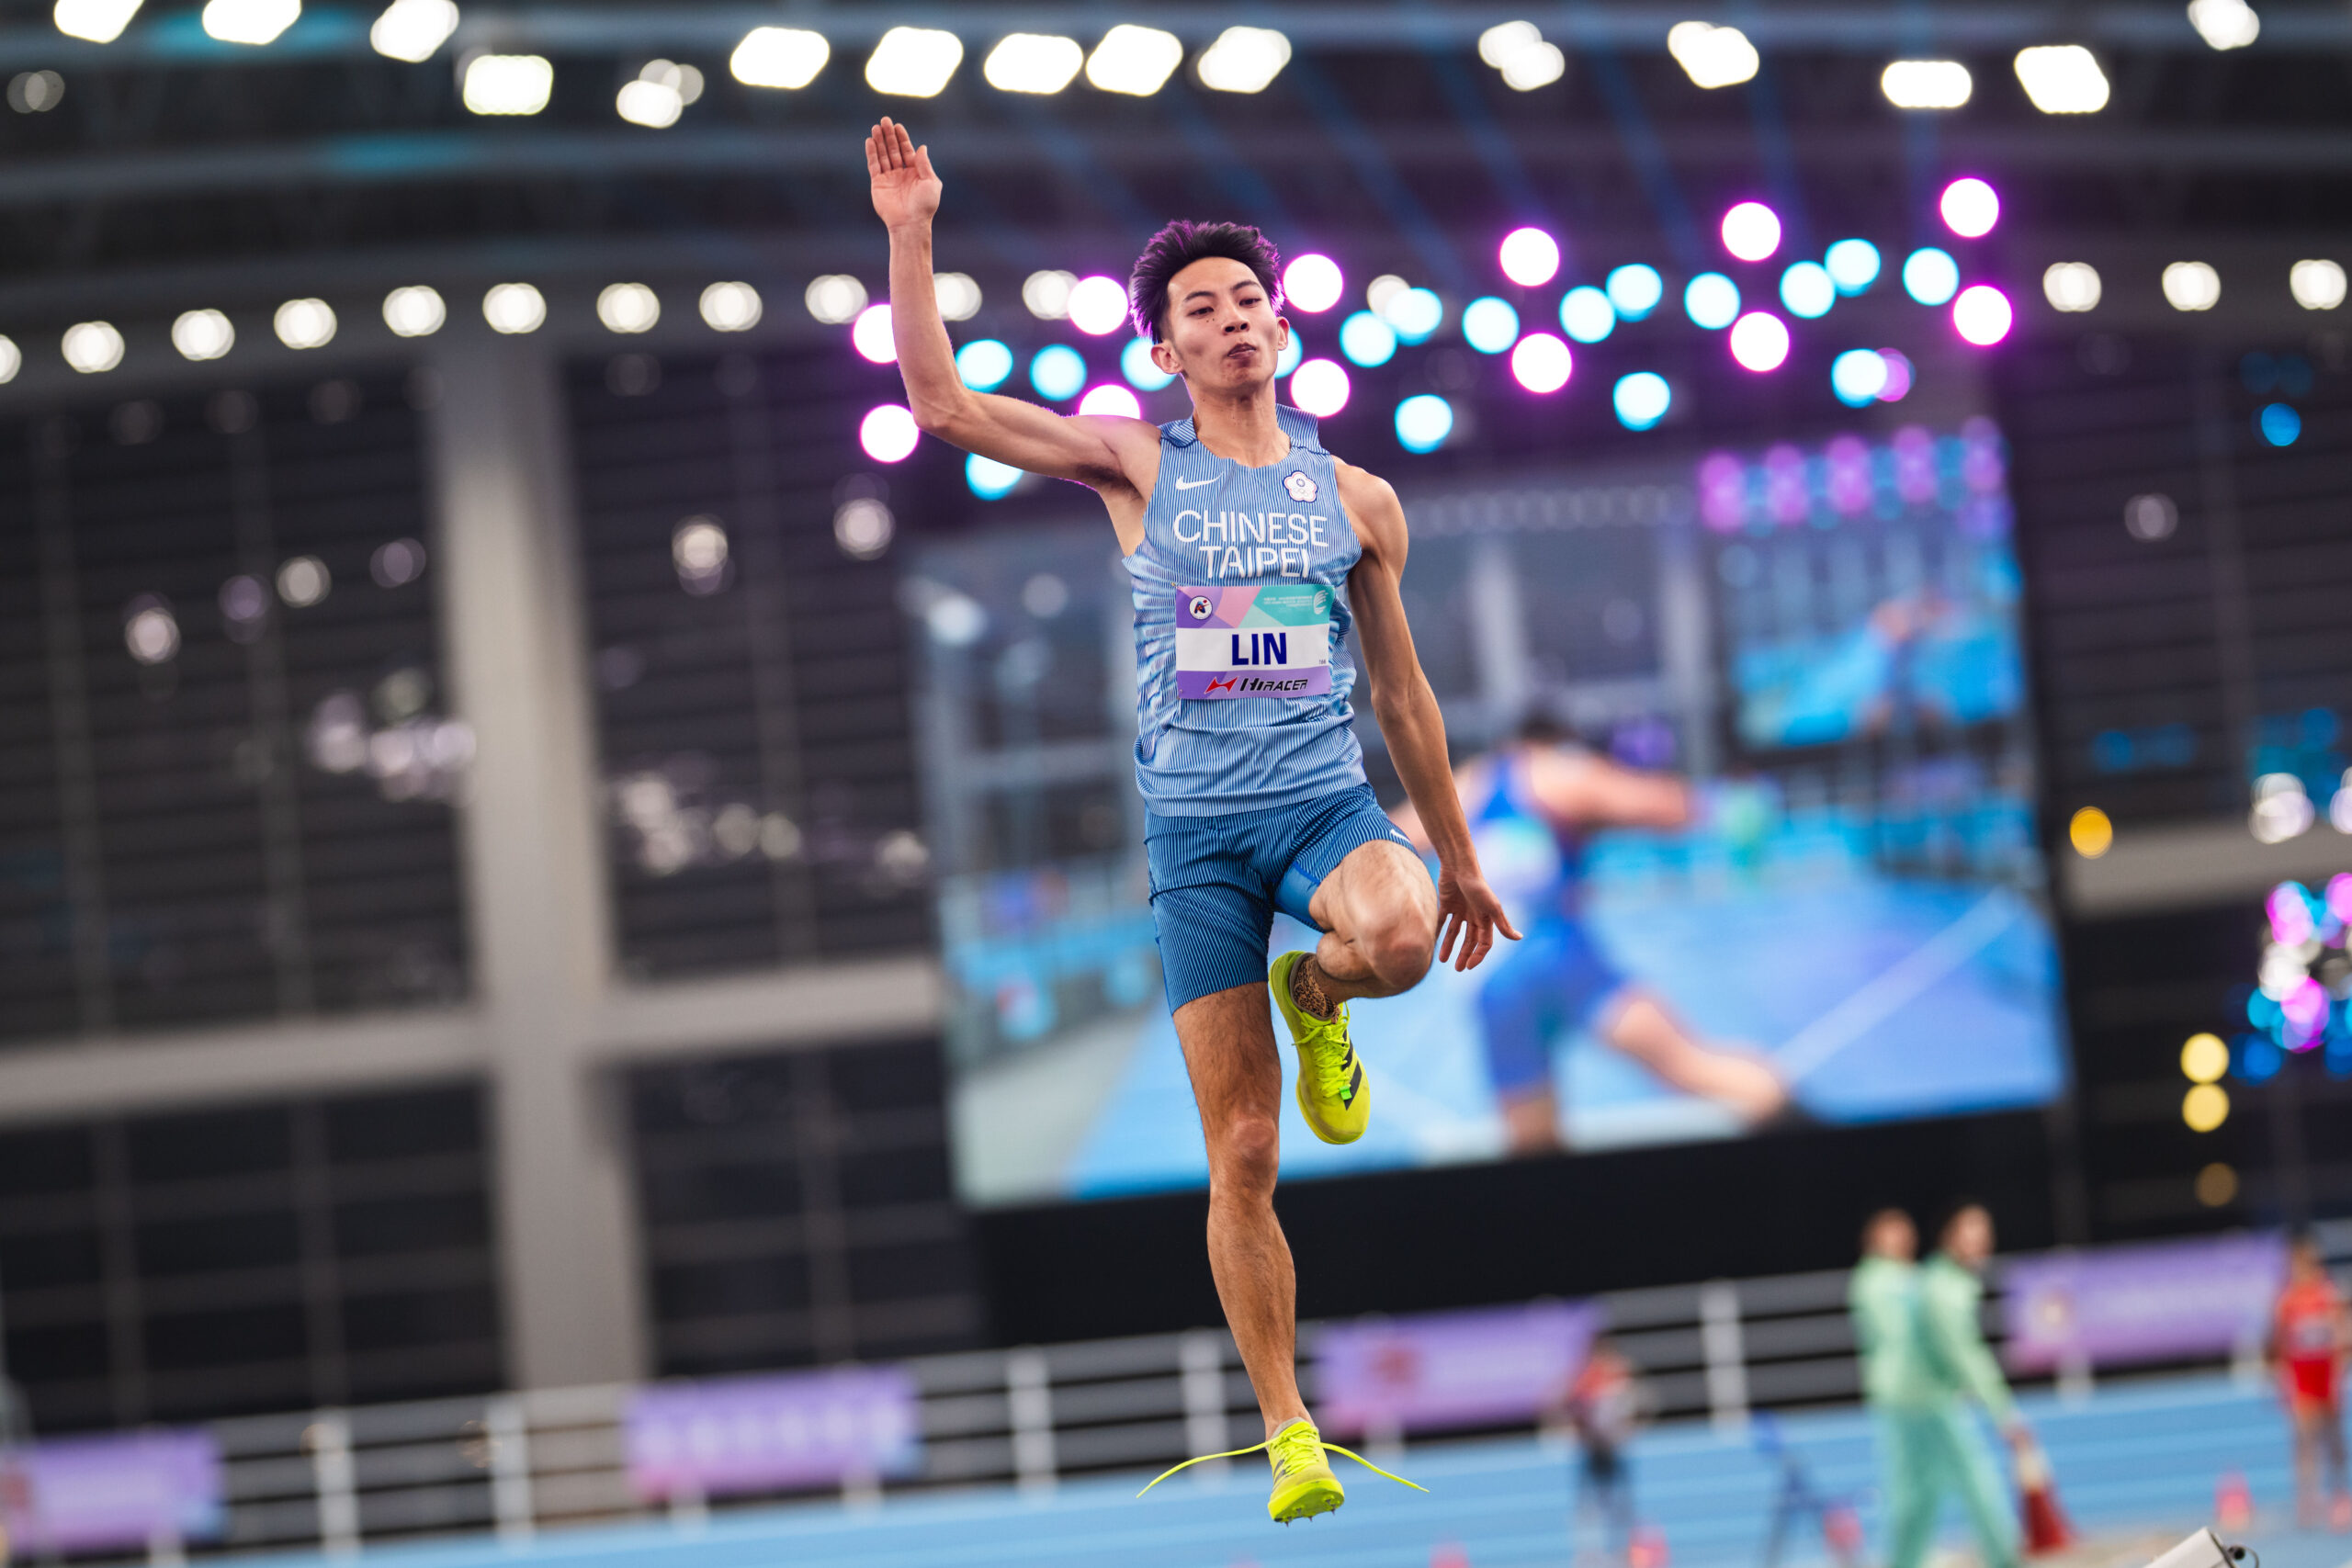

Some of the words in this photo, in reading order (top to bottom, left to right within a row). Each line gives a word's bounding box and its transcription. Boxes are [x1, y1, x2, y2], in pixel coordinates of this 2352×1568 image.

[1173, 510, 1329, 547] CHINESE
[1199, 546, 1309, 579] TAIPEI
[1231, 632, 1287, 666] LIN
